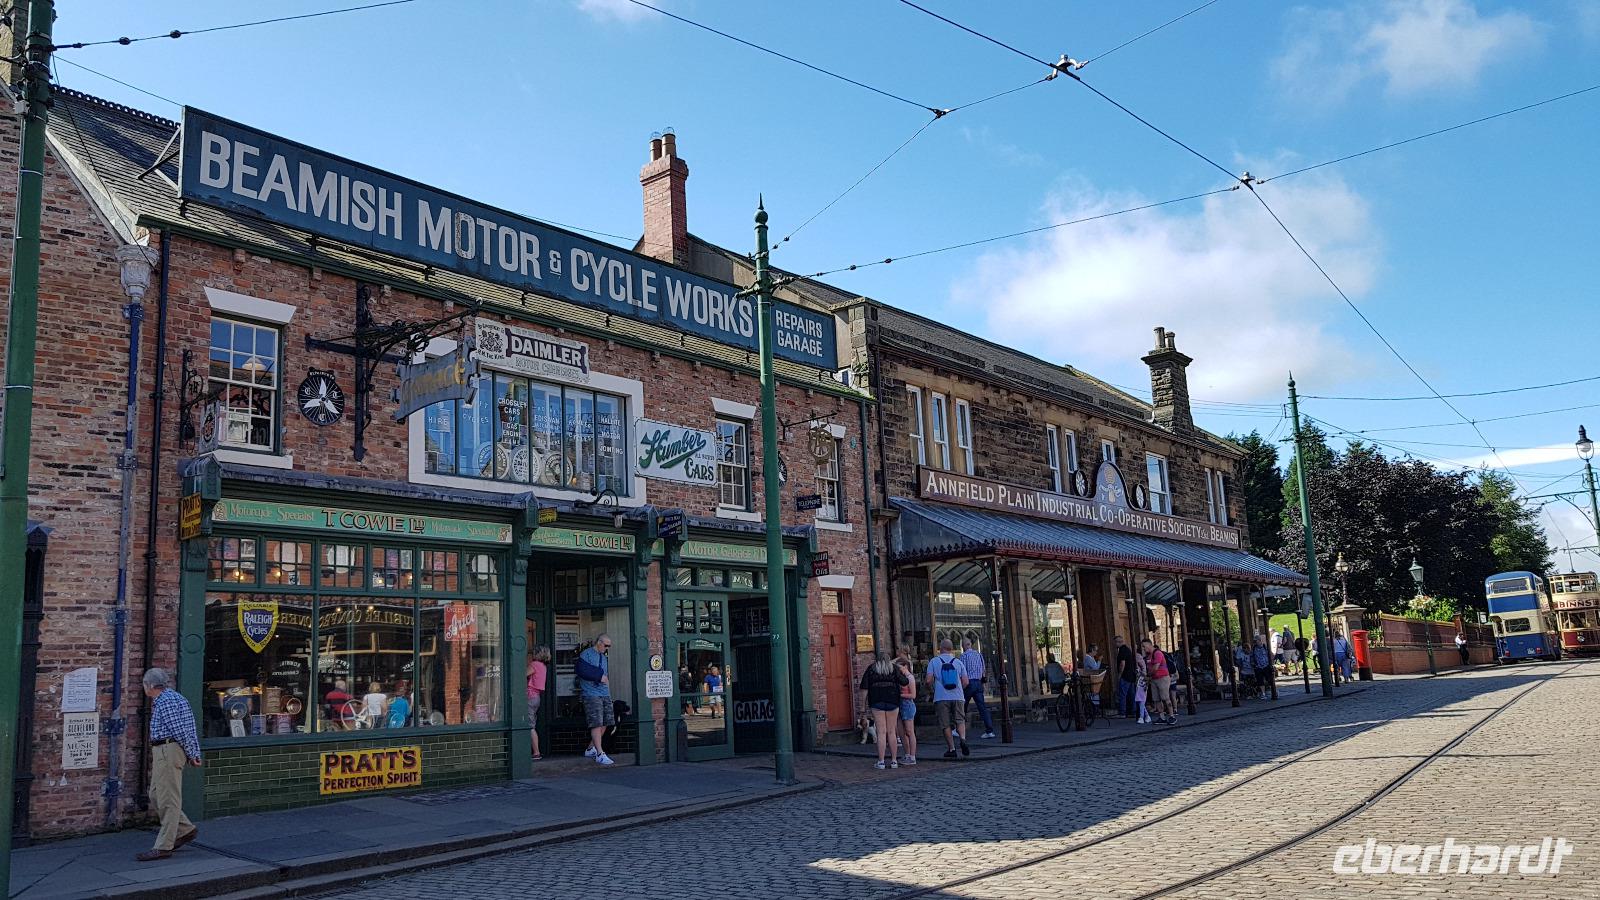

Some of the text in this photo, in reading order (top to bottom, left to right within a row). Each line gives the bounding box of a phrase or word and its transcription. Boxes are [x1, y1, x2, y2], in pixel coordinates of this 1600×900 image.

[200, 130, 754, 338] BEAMISH MOTOR & CYCLE WORKS
[775, 309, 822, 339] REPAIRS
[511, 335, 582, 367] DAIMLER
[777, 331, 822, 357] GARAGE
[498, 397, 527, 409] CROSSLEY
[504, 406, 521, 416] CARS
[428, 416, 448, 426] HIRE
[462, 413, 489, 424] CYCES
[639, 429, 706, 468] Humber
[684, 457, 714, 481] CARS
[925, 470, 994, 503] ANNFIELD
[998, 484, 1035, 510] PLAIN
[1036, 491, 1099, 521] INDUSTRIAL
[1168, 518, 1201, 539] SOCIETY
[1210, 525, 1239, 545] BEAMISH
[277, 507, 315, 521] Specialist
[339, 511, 405, 533] COWIE
[584, 534, 618, 549] COWIE
[688, 541, 719, 556] MOTOR
[1559, 600, 1593, 608] BINNS
[243, 611, 273, 625] RALEIGH
[446, 606, 477, 639] Ariel
[246, 625, 268, 637] Cycles
[734, 700, 775, 722] GARAG
[324, 749, 418, 777] PRATT'S
[323, 771, 418, 791] PERFECTION SPIRIT
